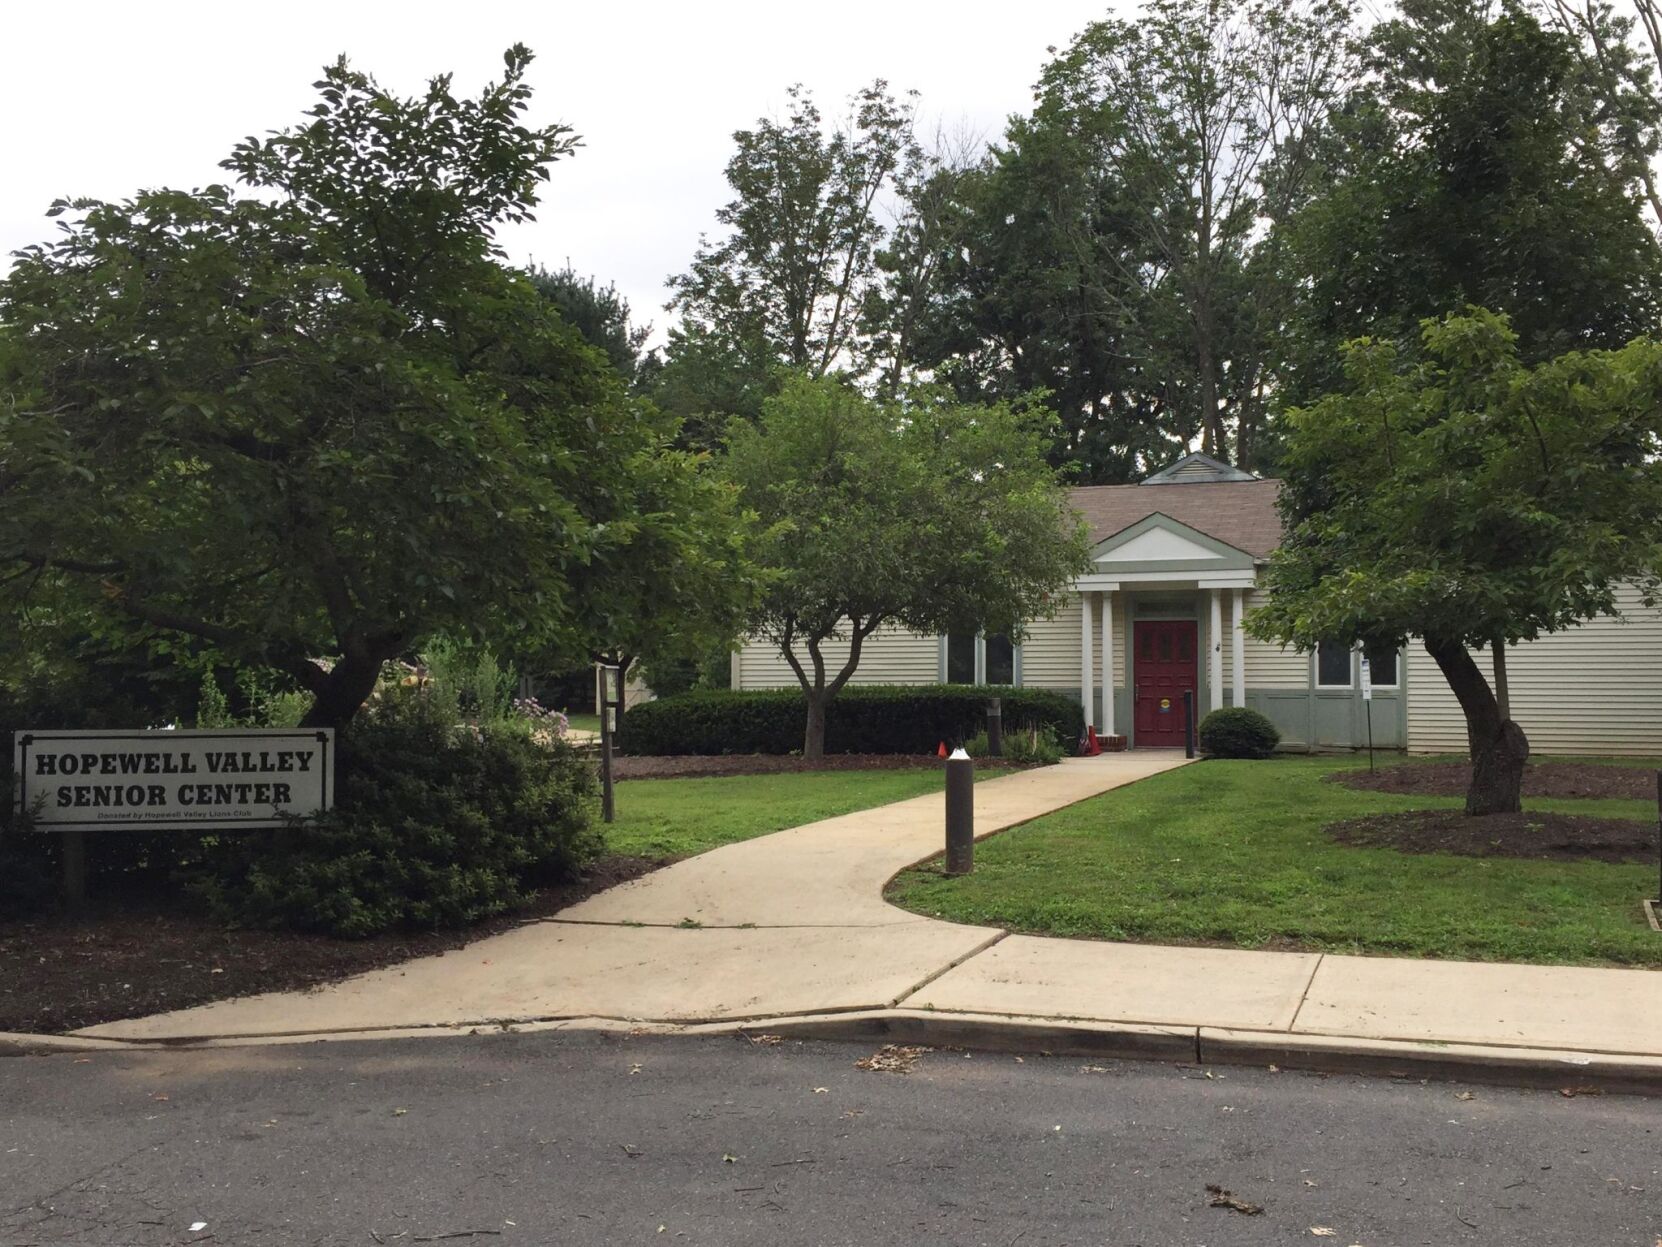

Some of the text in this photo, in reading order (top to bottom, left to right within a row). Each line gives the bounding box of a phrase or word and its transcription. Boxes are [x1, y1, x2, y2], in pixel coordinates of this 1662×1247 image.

[36, 751, 314, 775] HOPEWELL VALLEY
[57, 783, 291, 807] SENIOR CENTER
[97, 812, 132, 820] Donated
[133, 812, 143, 820] by
[144, 811, 182, 819] Hopewell
[183, 810, 207, 819] Valley
[209, 810, 231, 818] Lions
